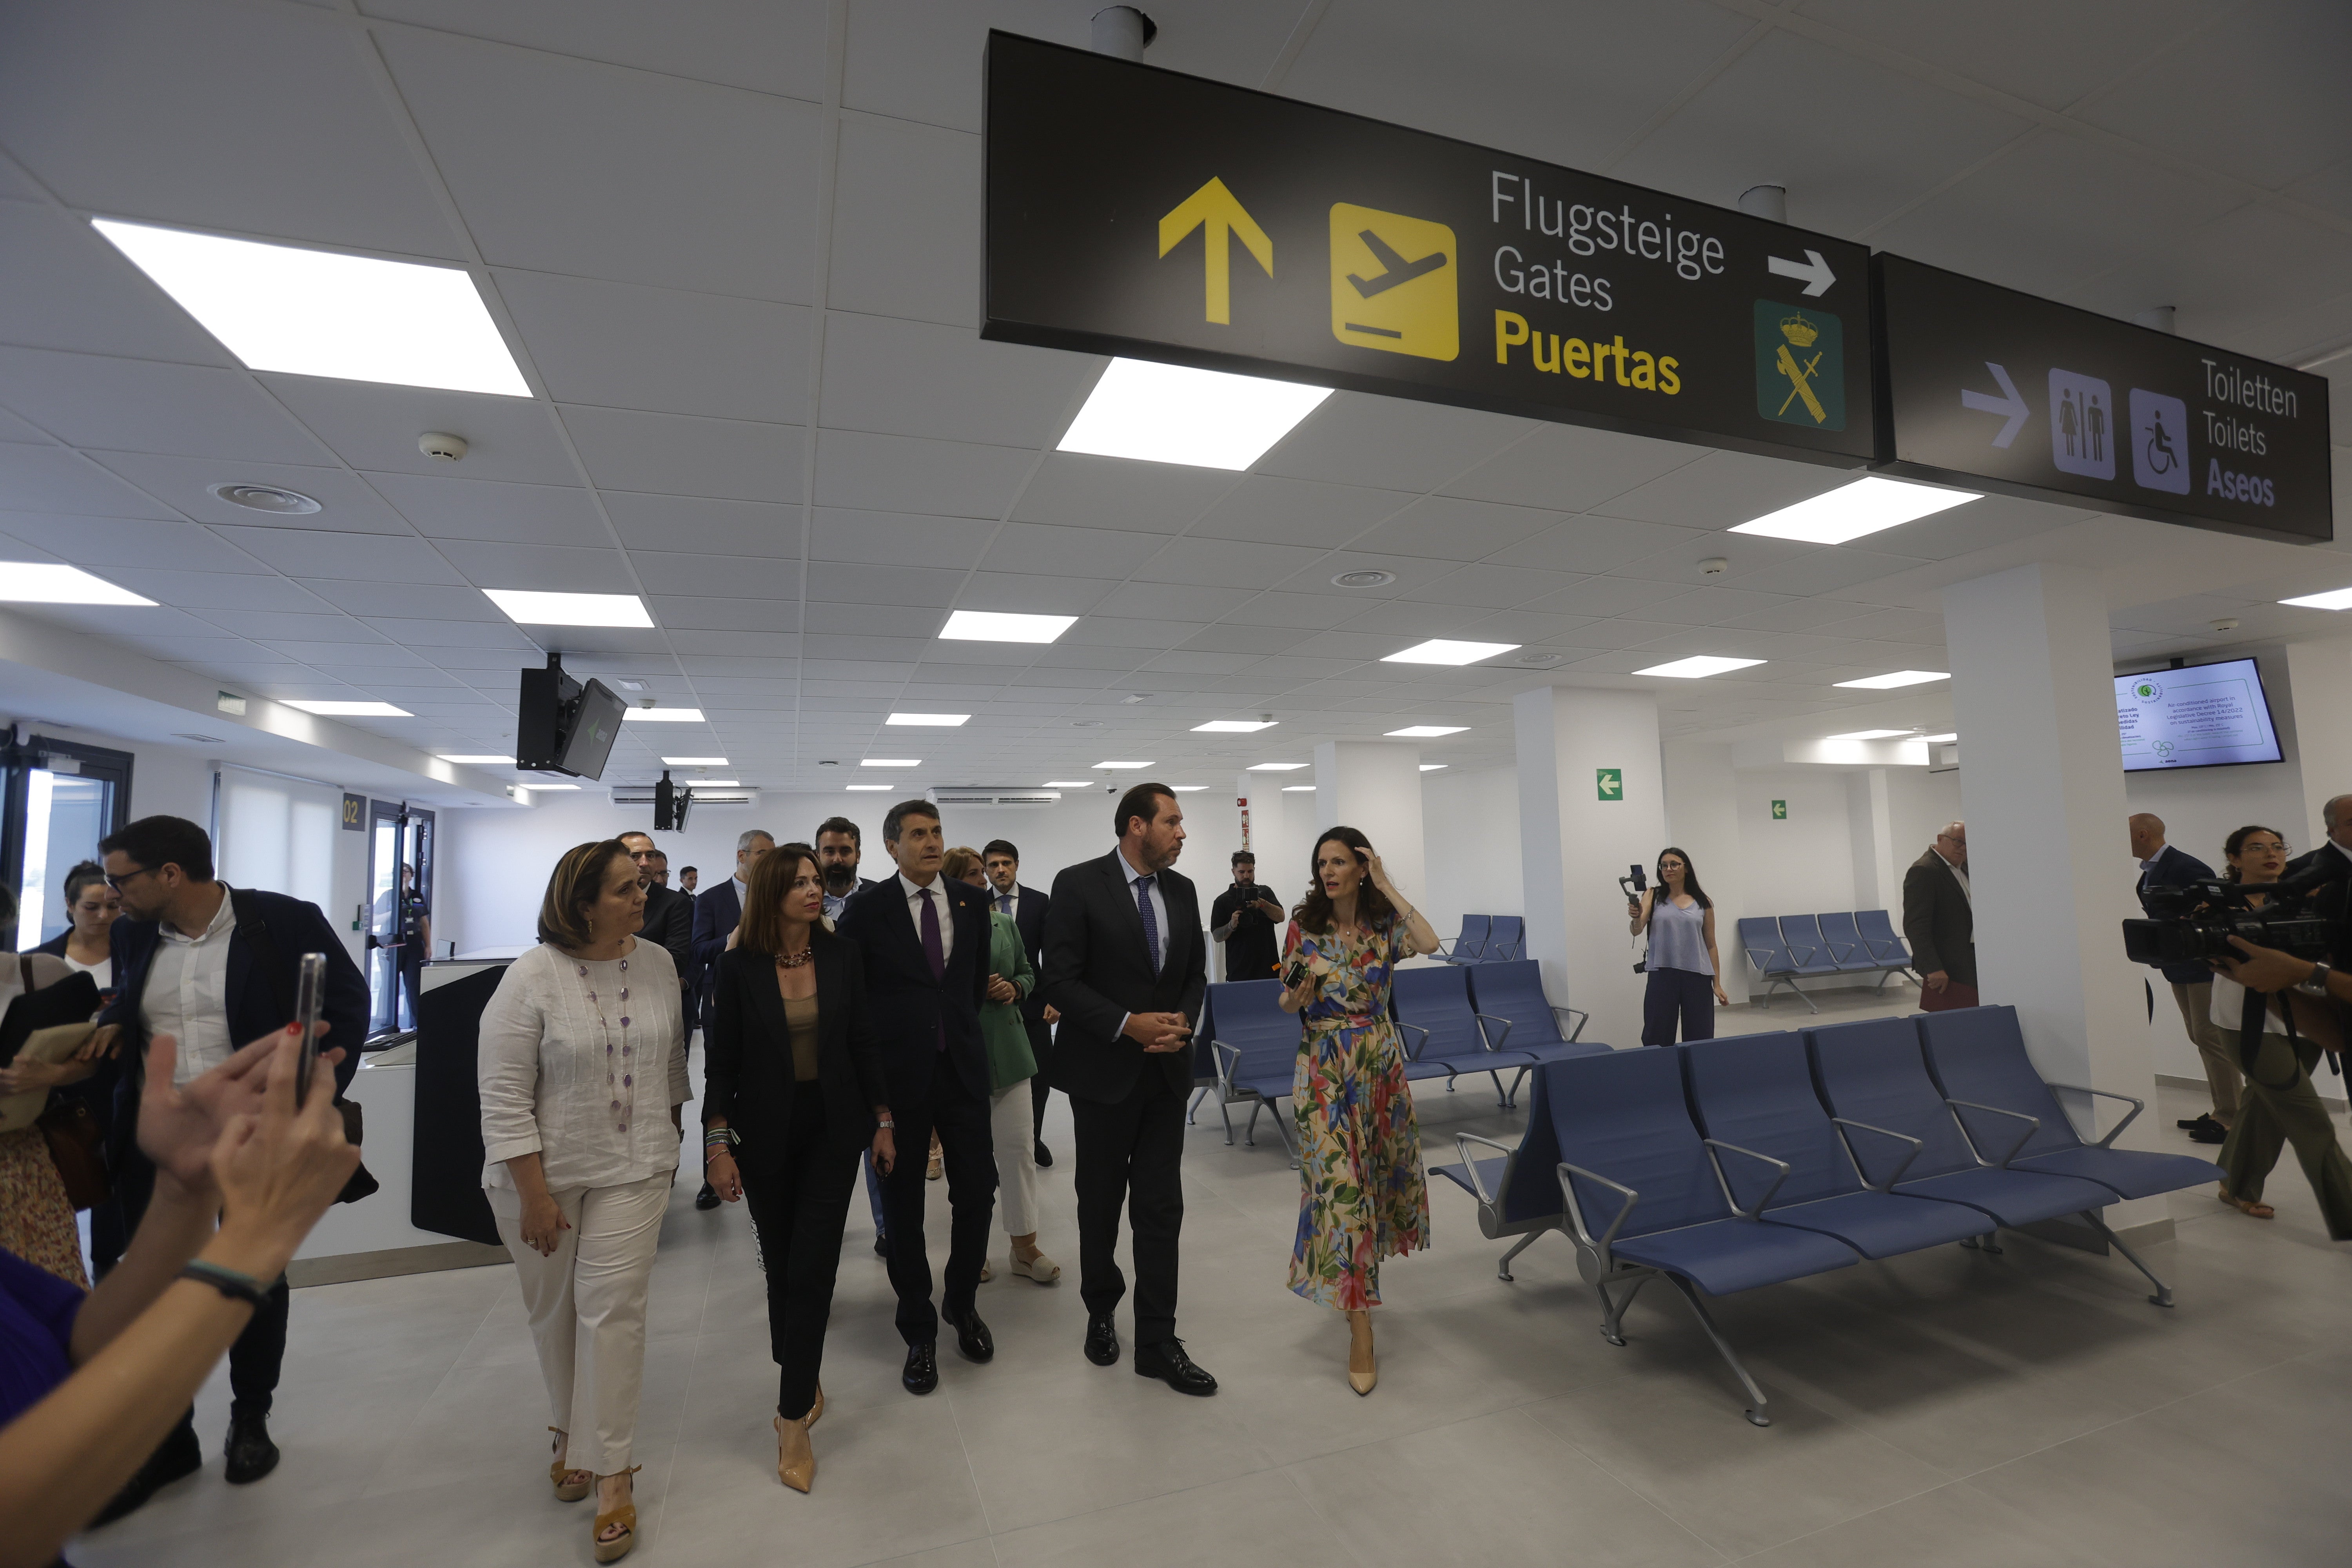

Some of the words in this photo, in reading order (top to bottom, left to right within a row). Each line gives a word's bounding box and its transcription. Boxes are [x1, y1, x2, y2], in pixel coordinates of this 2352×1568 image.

[1492, 170, 1725, 281] Flugsteige
[1494, 245, 1613, 311] Gates
[1494, 309, 1681, 395] Puertas
[2201, 359, 2297, 418] Toiletten
[2202, 410, 2267, 456] Toilets
[2207, 458, 2275, 507] Aseos
[2168, 699, 2208, 708] Air-conditioned
[344, 800, 358, 823] 02
